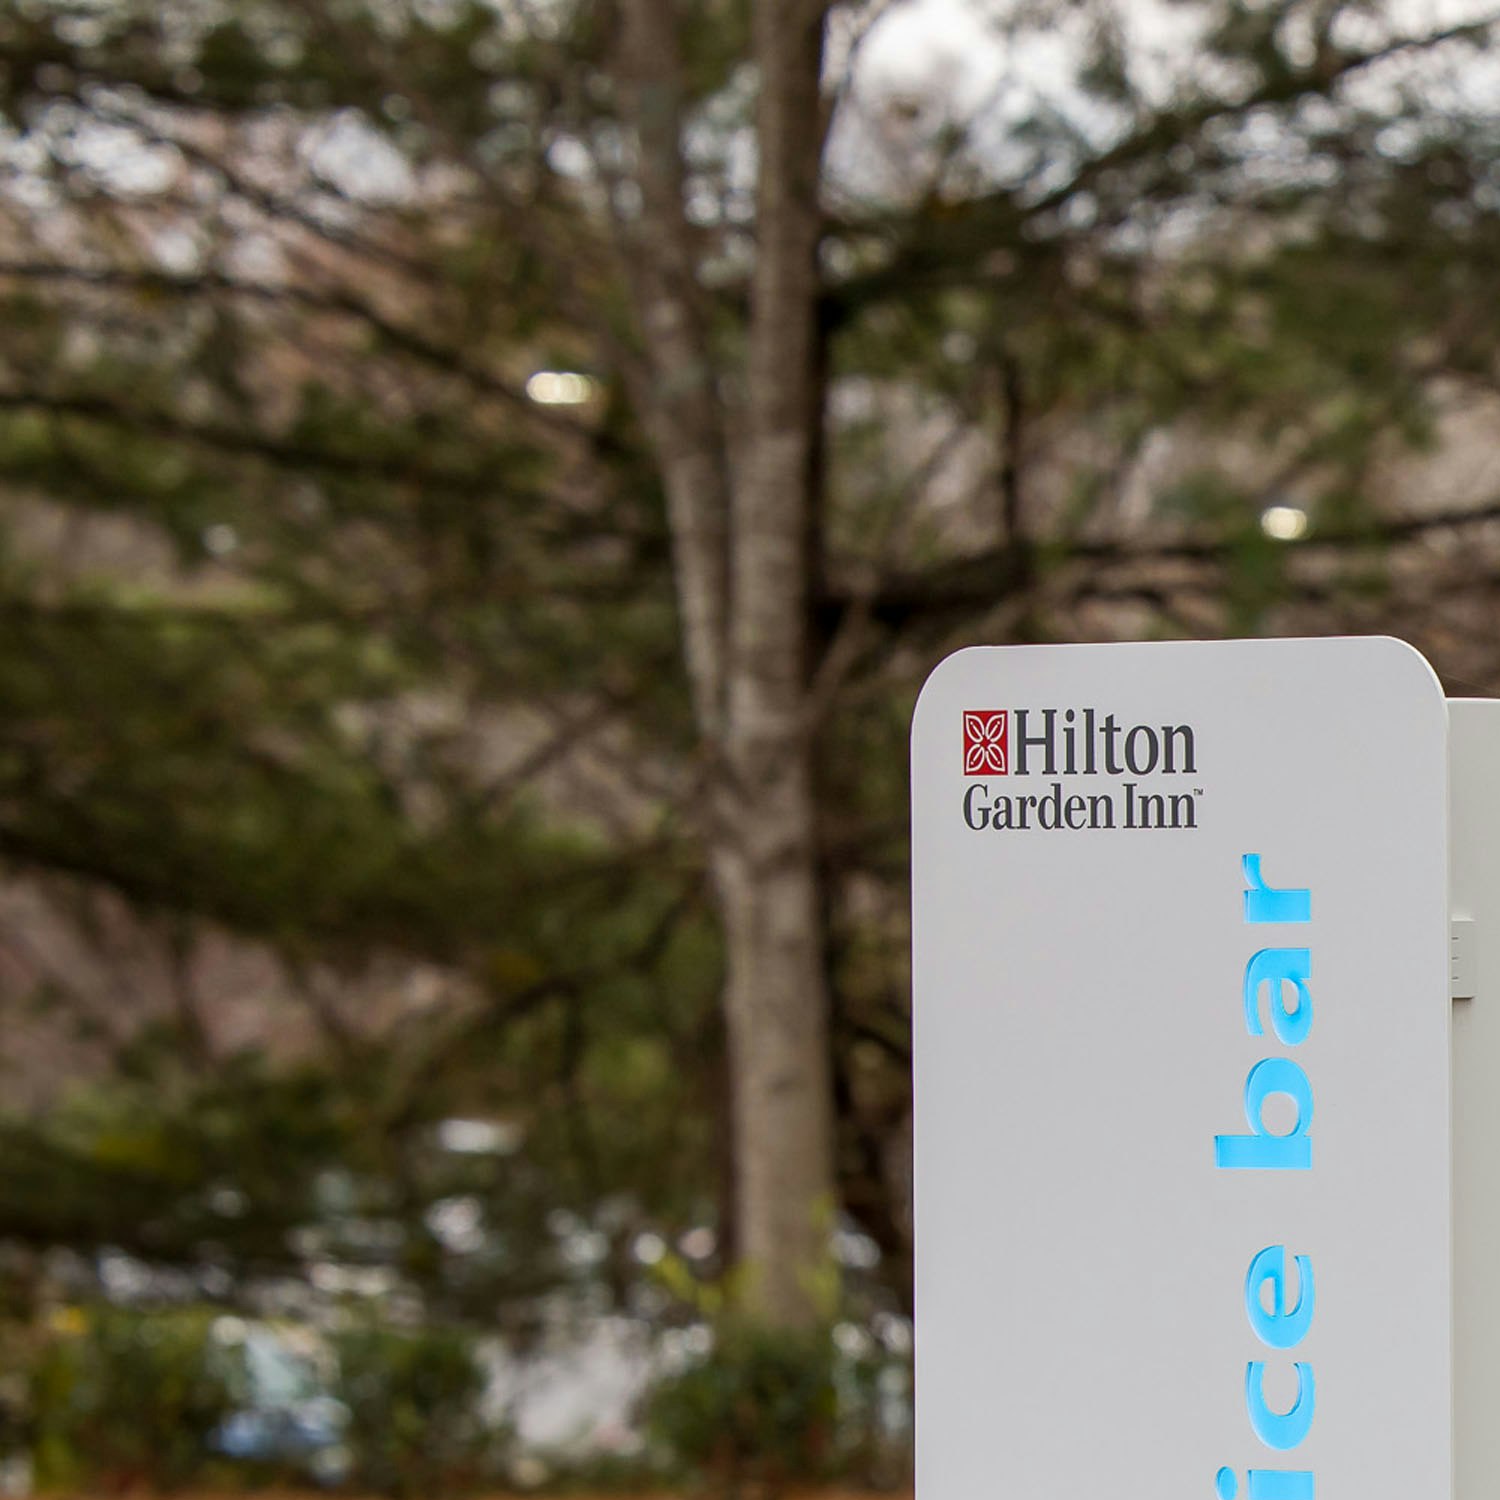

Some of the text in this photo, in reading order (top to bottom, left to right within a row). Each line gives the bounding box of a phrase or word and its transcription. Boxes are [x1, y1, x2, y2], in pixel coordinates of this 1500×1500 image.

[1013, 708, 1198, 775] Hilton
[963, 783, 1116, 830] Garden
[1214, 853, 1313, 1170] bar
